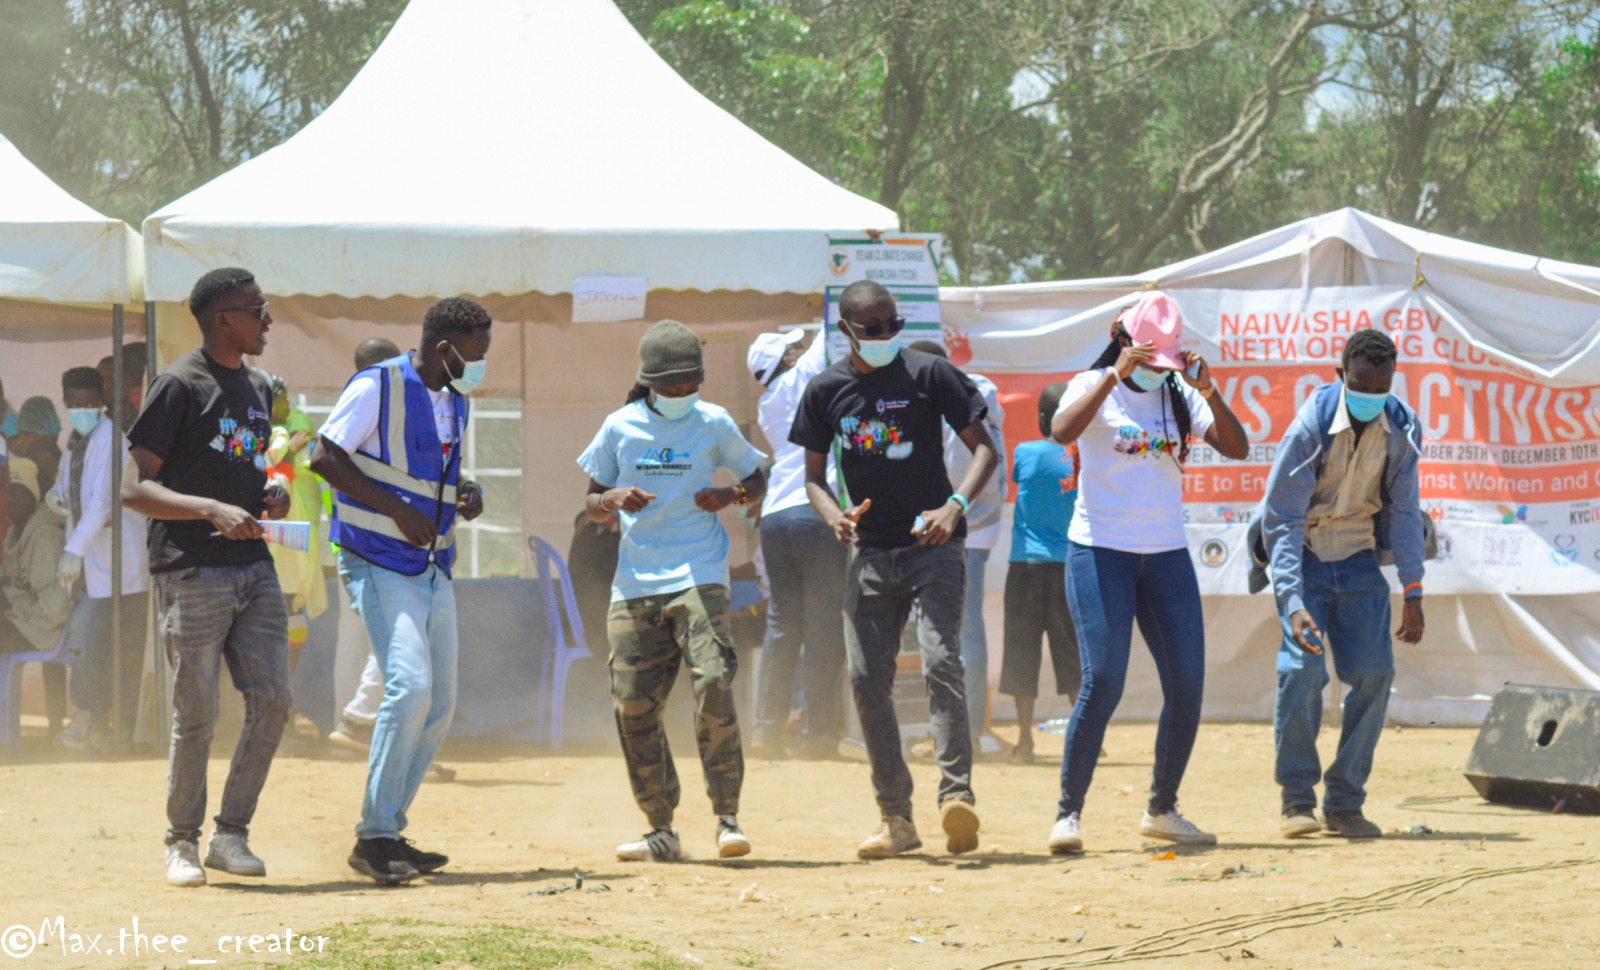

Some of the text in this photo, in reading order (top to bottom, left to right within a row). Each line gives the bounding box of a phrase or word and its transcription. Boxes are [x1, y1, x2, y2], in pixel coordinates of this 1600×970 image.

[856, 250, 925, 262] TEAM CLIMATE CHANGE
[1221, 308, 1443, 335] NAIVASHA GBV
[1421, 445, 1452, 460] MBER
[1457, 446, 1488, 461] 25TH
[1502, 446, 1566, 464] DECEMBER
[1571, 444, 1598, 459] 10TH
[1212, 475, 1233, 493] to
[1241, 472, 1265, 492] En
[1419, 470, 1456, 490] inst
[1464, 471, 1543, 493] Women
[1551, 473, 1588, 492] and
